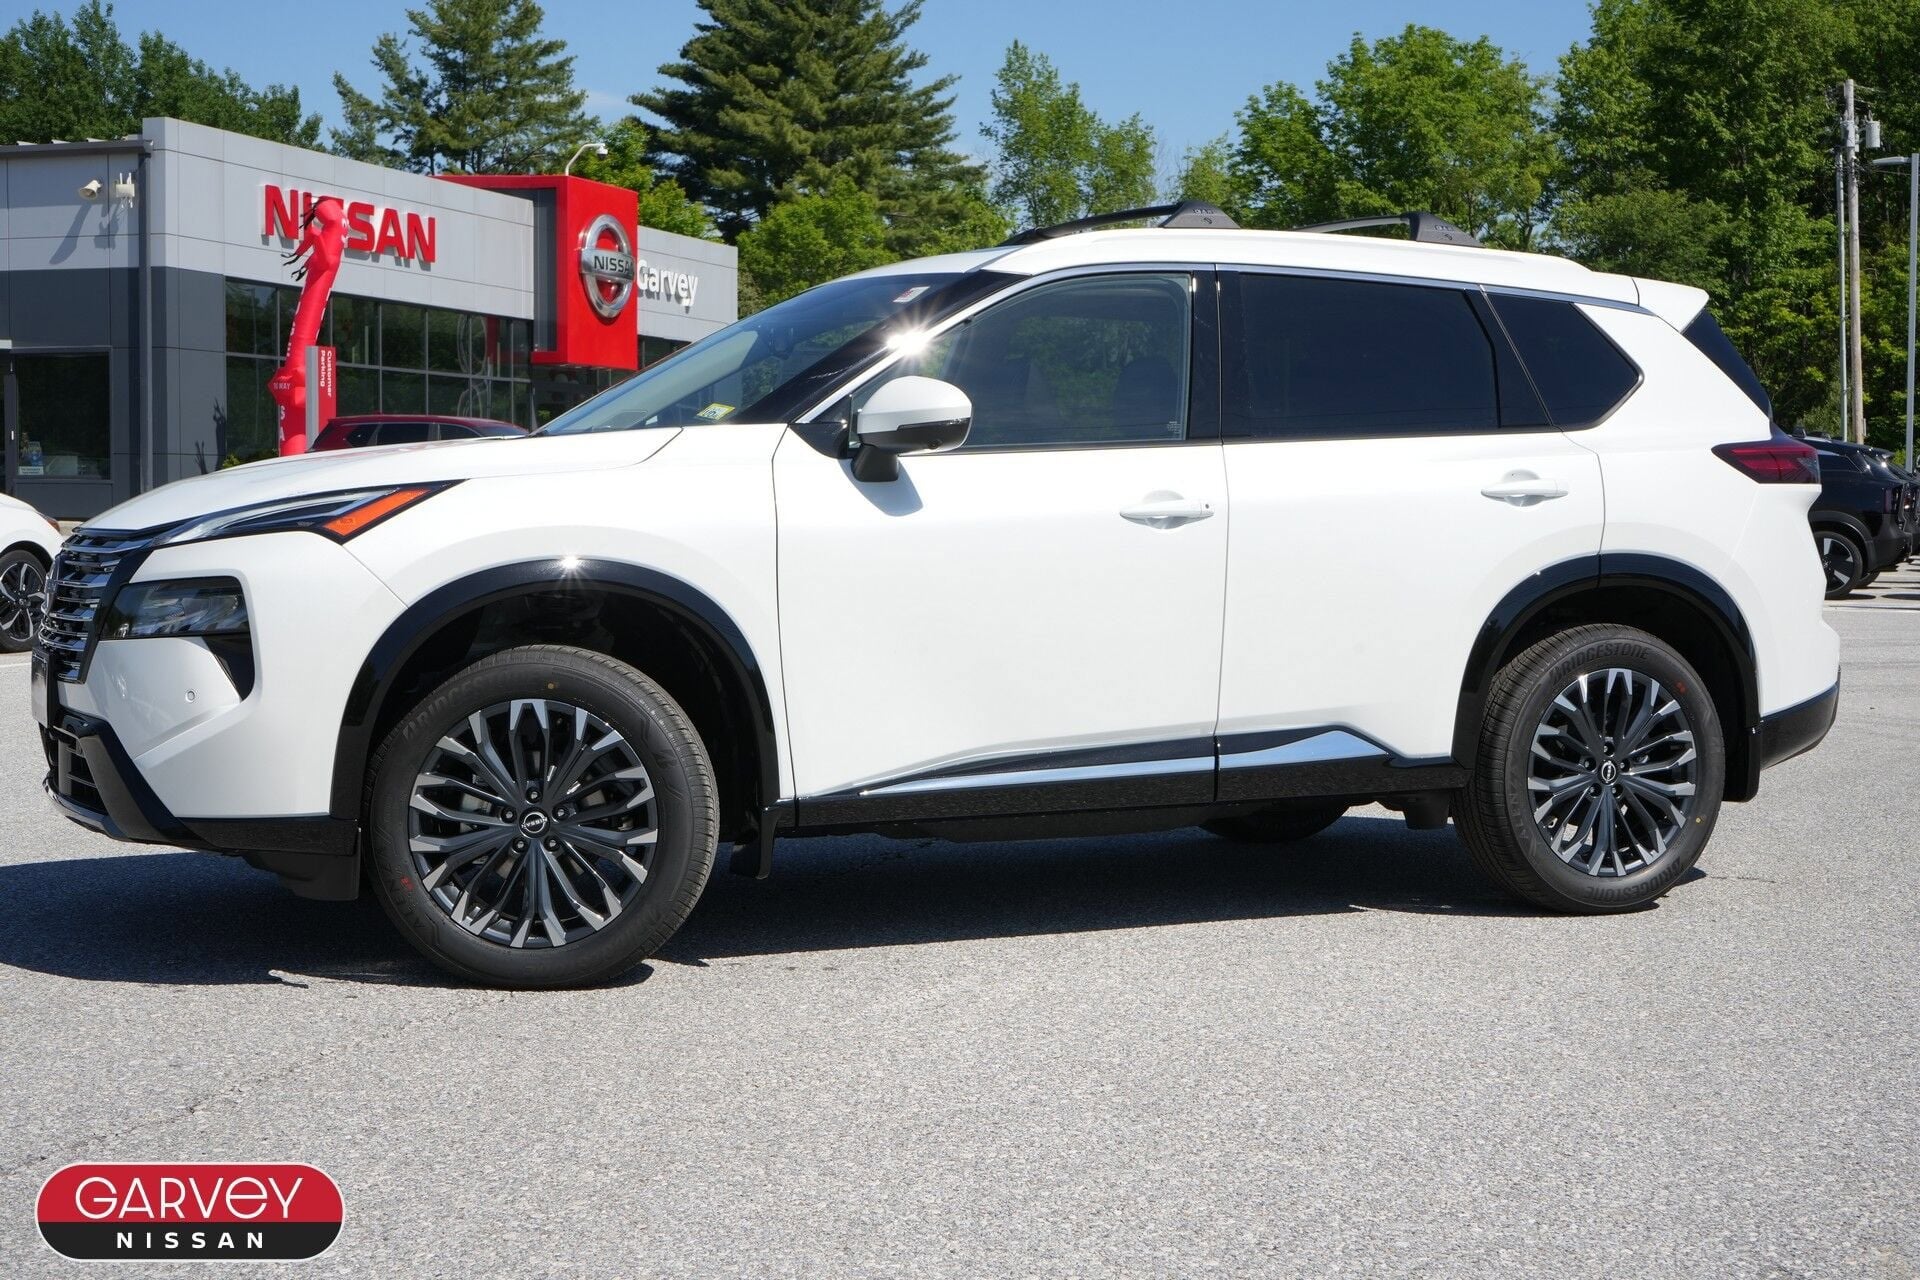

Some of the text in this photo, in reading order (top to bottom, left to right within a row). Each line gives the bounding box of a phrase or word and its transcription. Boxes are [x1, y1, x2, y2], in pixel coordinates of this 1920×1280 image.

[594, 255, 633, 274] NISSA
[637, 259, 698, 307] Garvey
[1550, 642, 1650, 682] BRIDGESTONE
